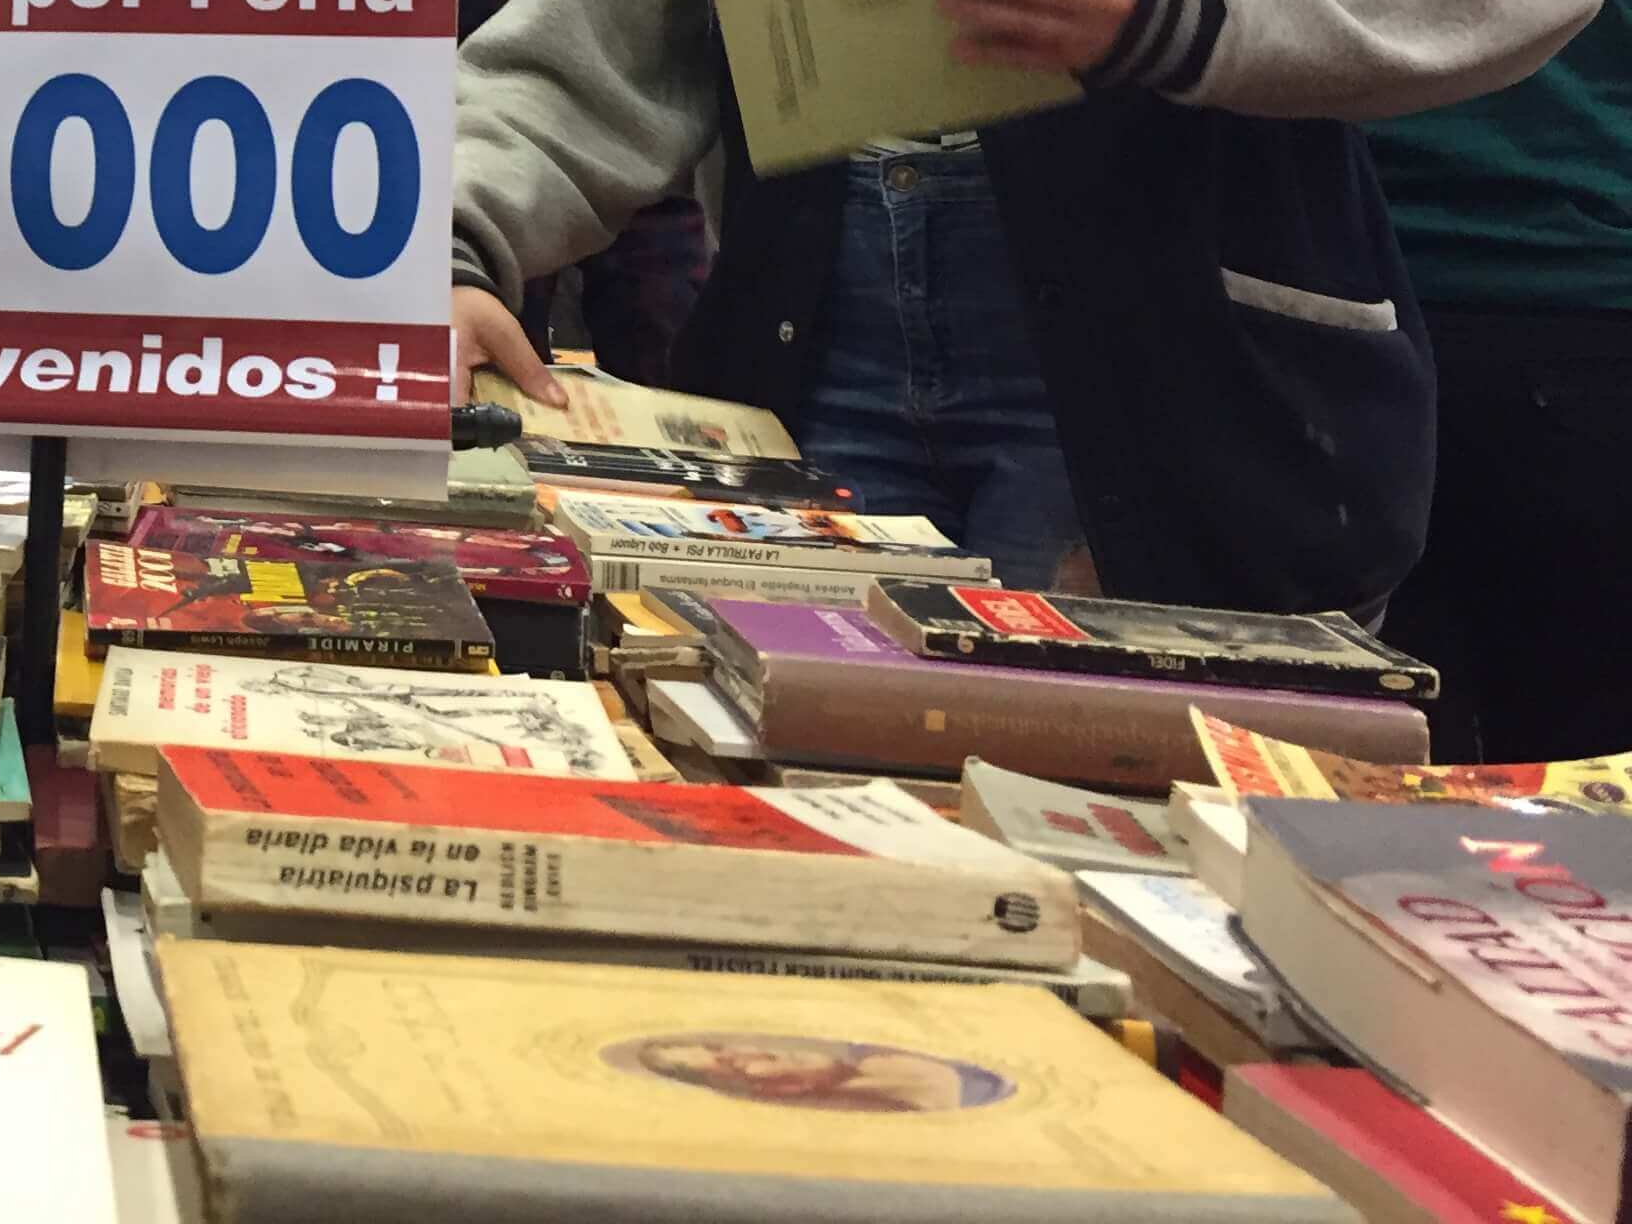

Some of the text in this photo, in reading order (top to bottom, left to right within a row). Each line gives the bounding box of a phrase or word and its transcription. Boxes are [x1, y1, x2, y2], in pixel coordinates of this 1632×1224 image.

[375, 343, 402, 402] !
[648, 542, 669, 554] Bob
[685, 543, 705, 556] PSI
[707, 545, 762, 560] PATRULLA
[765, 550, 780, 561] LA
[136, 548, 178, 593] 2001
[307, 636, 415, 654] PIRAMIDE
[1147, 654, 1186, 672] FIDEL
[245, 827, 480, 863] en la vida diaria
[445, 879, 478, 902] La
